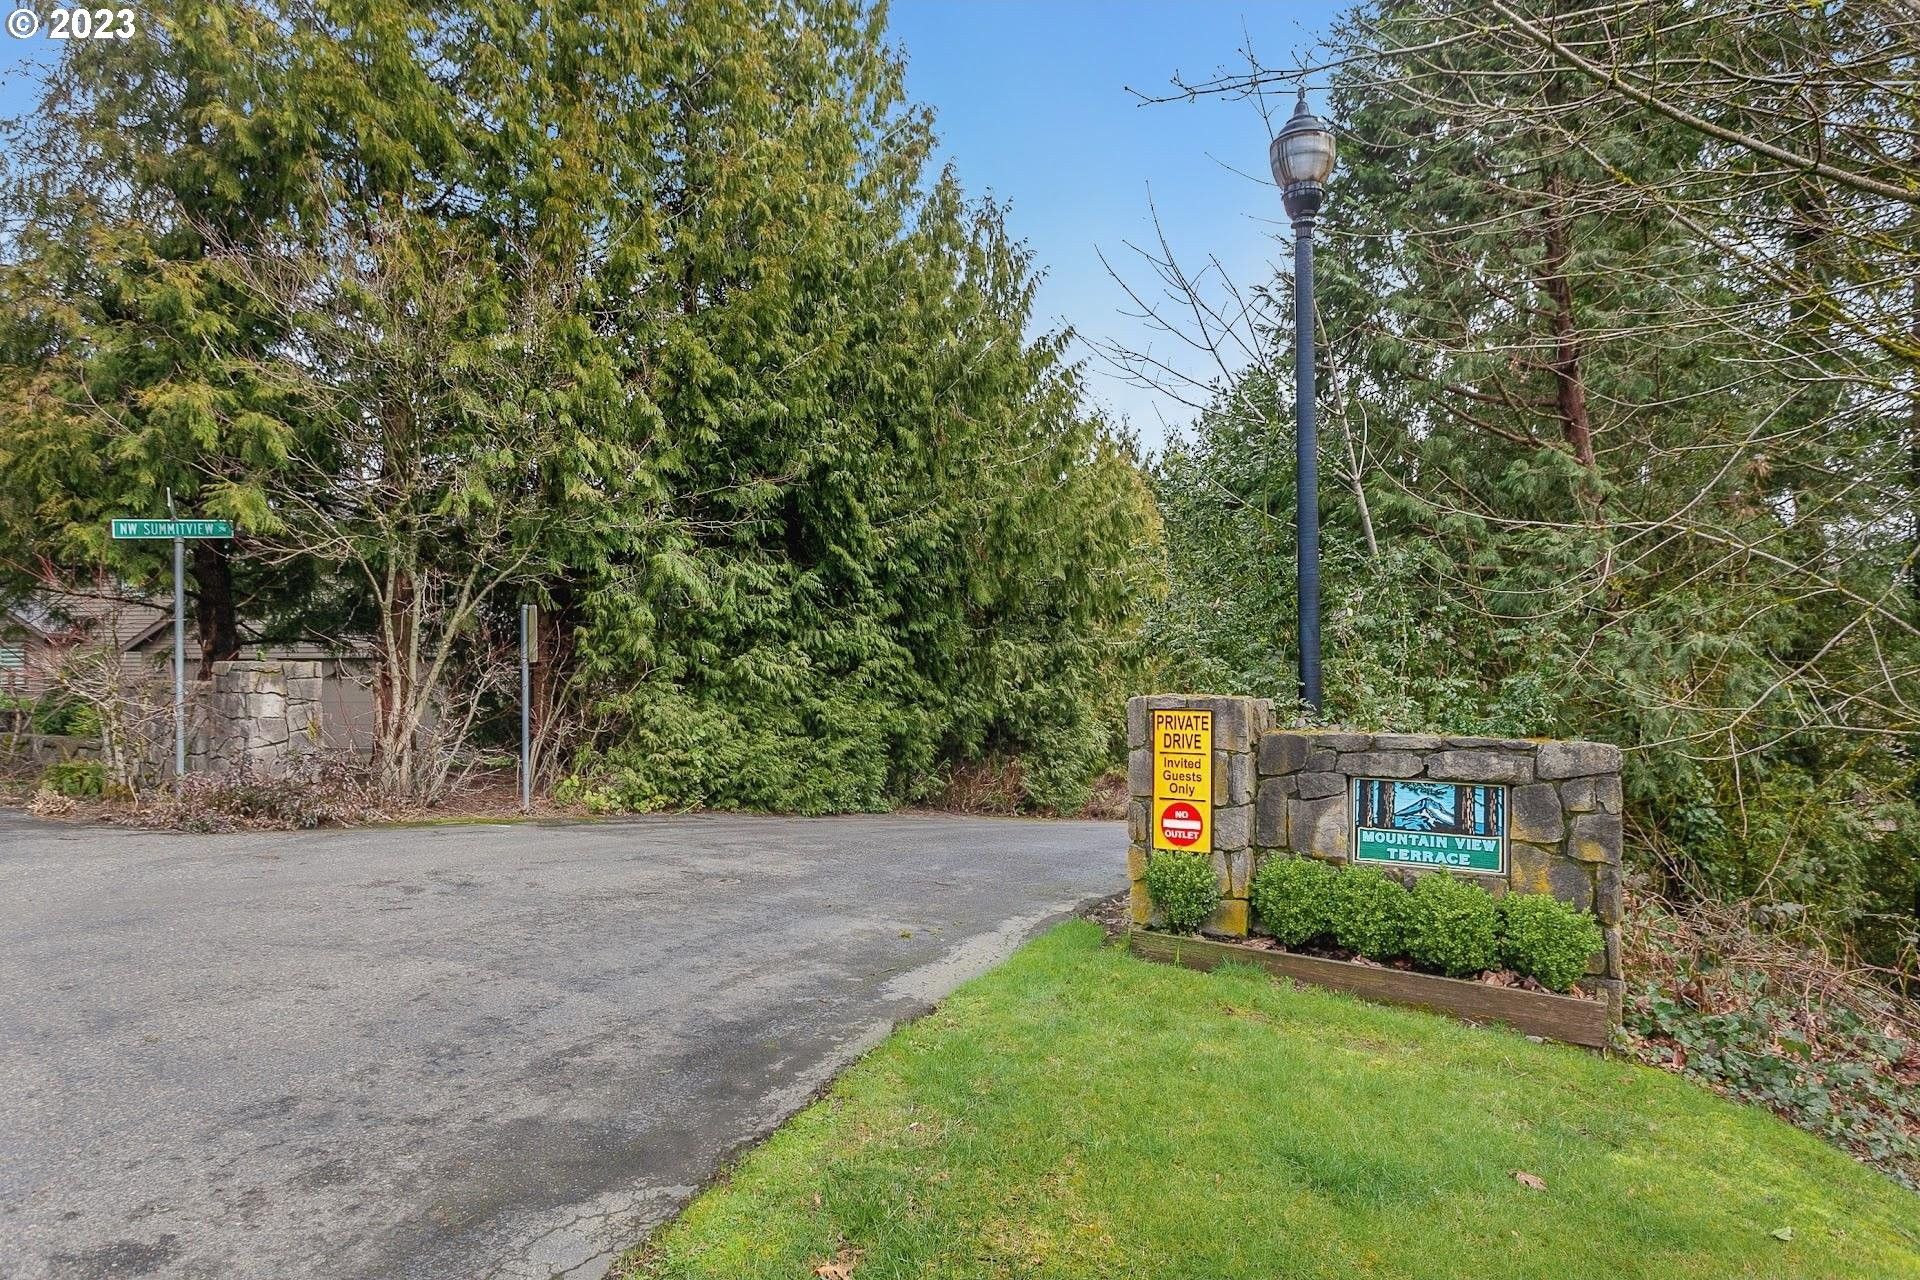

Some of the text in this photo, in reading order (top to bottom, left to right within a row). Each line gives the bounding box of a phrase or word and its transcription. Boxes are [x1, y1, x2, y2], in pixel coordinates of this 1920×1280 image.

[119, 523, 138, 535] NW
[143, 523, 214, 535] SUMMITVIEW
[1157, 715, 1209, 731] PRIVATE
[1164, 733, 1202, 749] DRIVE
[1163, 757, 1201, 769] Invited
[1163, 770, 1202, 782] Guests
[1169, 783, 1195, 797] Only
[1174, 810, 1189, 819] NO
[1164, 829, 1200, 840] OUTLET
[1362, 831, 1497, 852] MOUNTAIN VIEW
[1386, 848, 1471, 865] TERRACE
